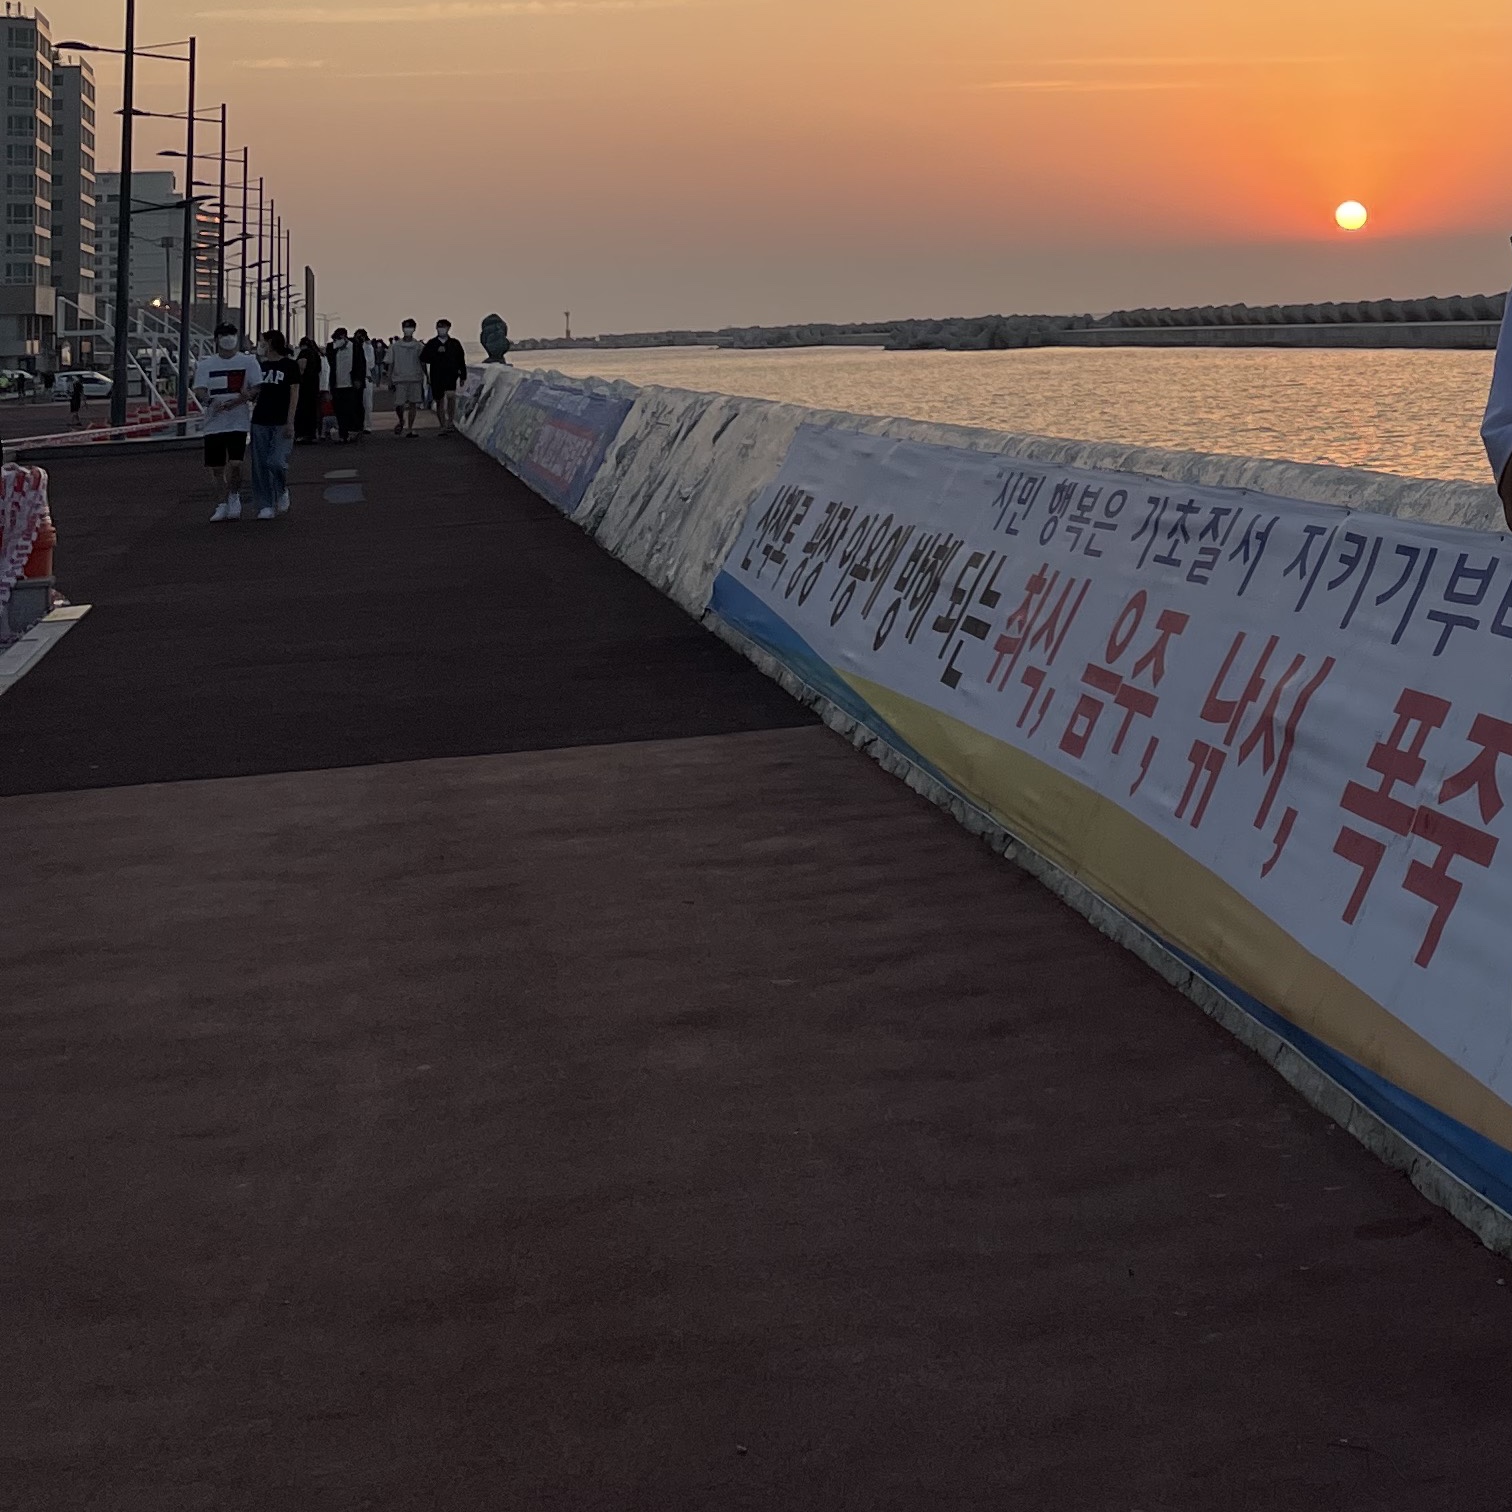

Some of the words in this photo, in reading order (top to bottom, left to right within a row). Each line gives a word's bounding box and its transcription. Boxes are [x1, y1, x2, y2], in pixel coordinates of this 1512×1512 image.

[1040, 478, 1128, 558] 행복은
[1131, 496, 1280, 596] 기초질서
[986, 563, 1092, 738] 취식,
[1059, 590, 1191, 797] 음주,
[1175, 631, 1336, 879] 낚시,
